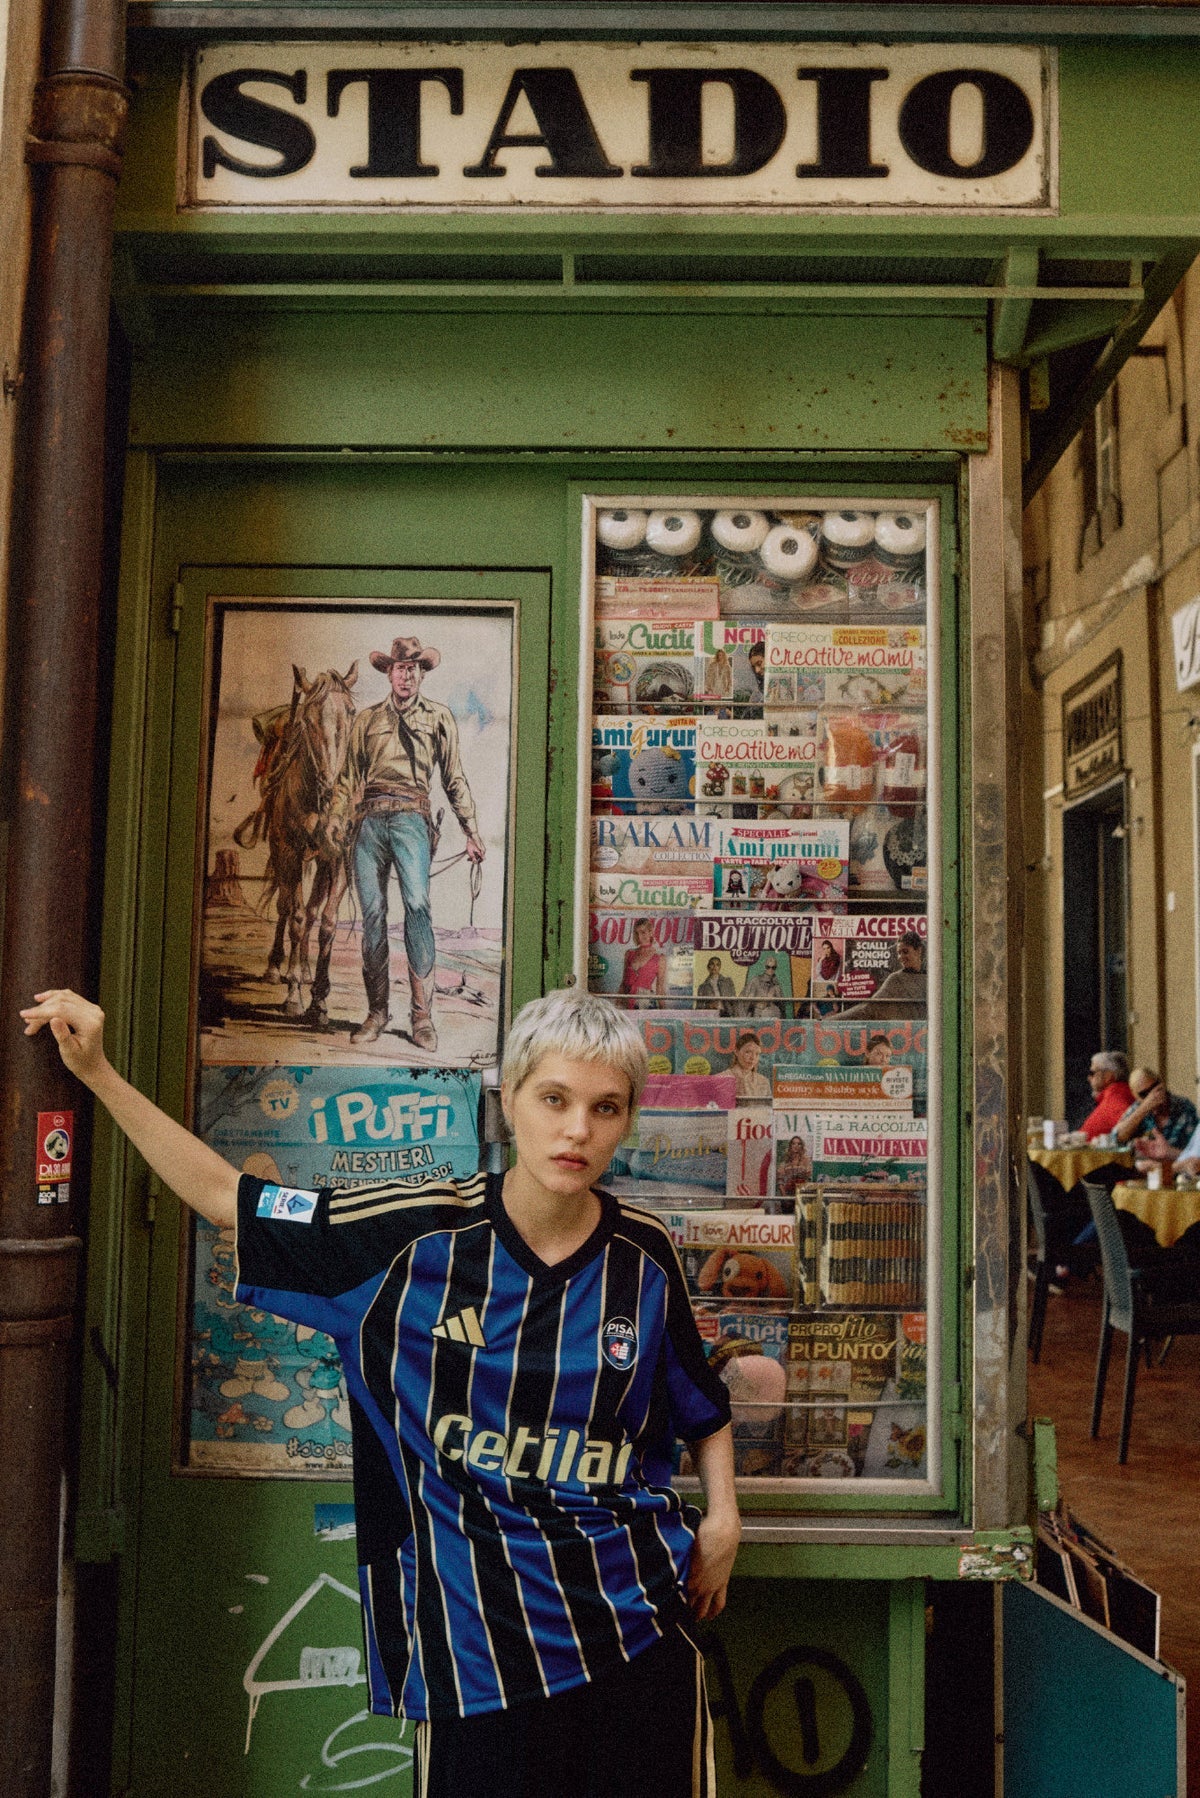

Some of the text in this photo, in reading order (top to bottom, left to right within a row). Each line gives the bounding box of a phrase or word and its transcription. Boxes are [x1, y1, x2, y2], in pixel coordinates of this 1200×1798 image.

[202, 67, 1034, 178] STADIO
[771, 631, 806, 643] CREO
[838, 636, 887, 645] COLLEZIONE
[702, 726, 738, 737] CREO
[597, 820, 711, 848] RAKAM
[737, 828, 786, 839] SPECIALE
[619, 879, 689, 906] Cucito
[701, 920, 813, 953] BOUTIQUE
[856, 942, 888, 950] SCIALLI
[851, 951, 891, 959] PONCHO
[853, 960, 889, 968] SCIARPE
[776, 1085, 813, 1096] Country
[269, 1098, 289, 1111] TV
[825, 1121, 926, 1133] La RACCOLTA
[826, 1139, 926, 1155] MANI DI FATA
[331, 1144, 434, 1173] MESTIERI
[313, 1173, 328, 1188] 14
[432, 1162, 454, 1180] 3D!
[607, 1323, 635, 1337] PISA
[813, 1341, 890, 1359] PUNTO
[434, 1414, 633, 1485] Cetilar
